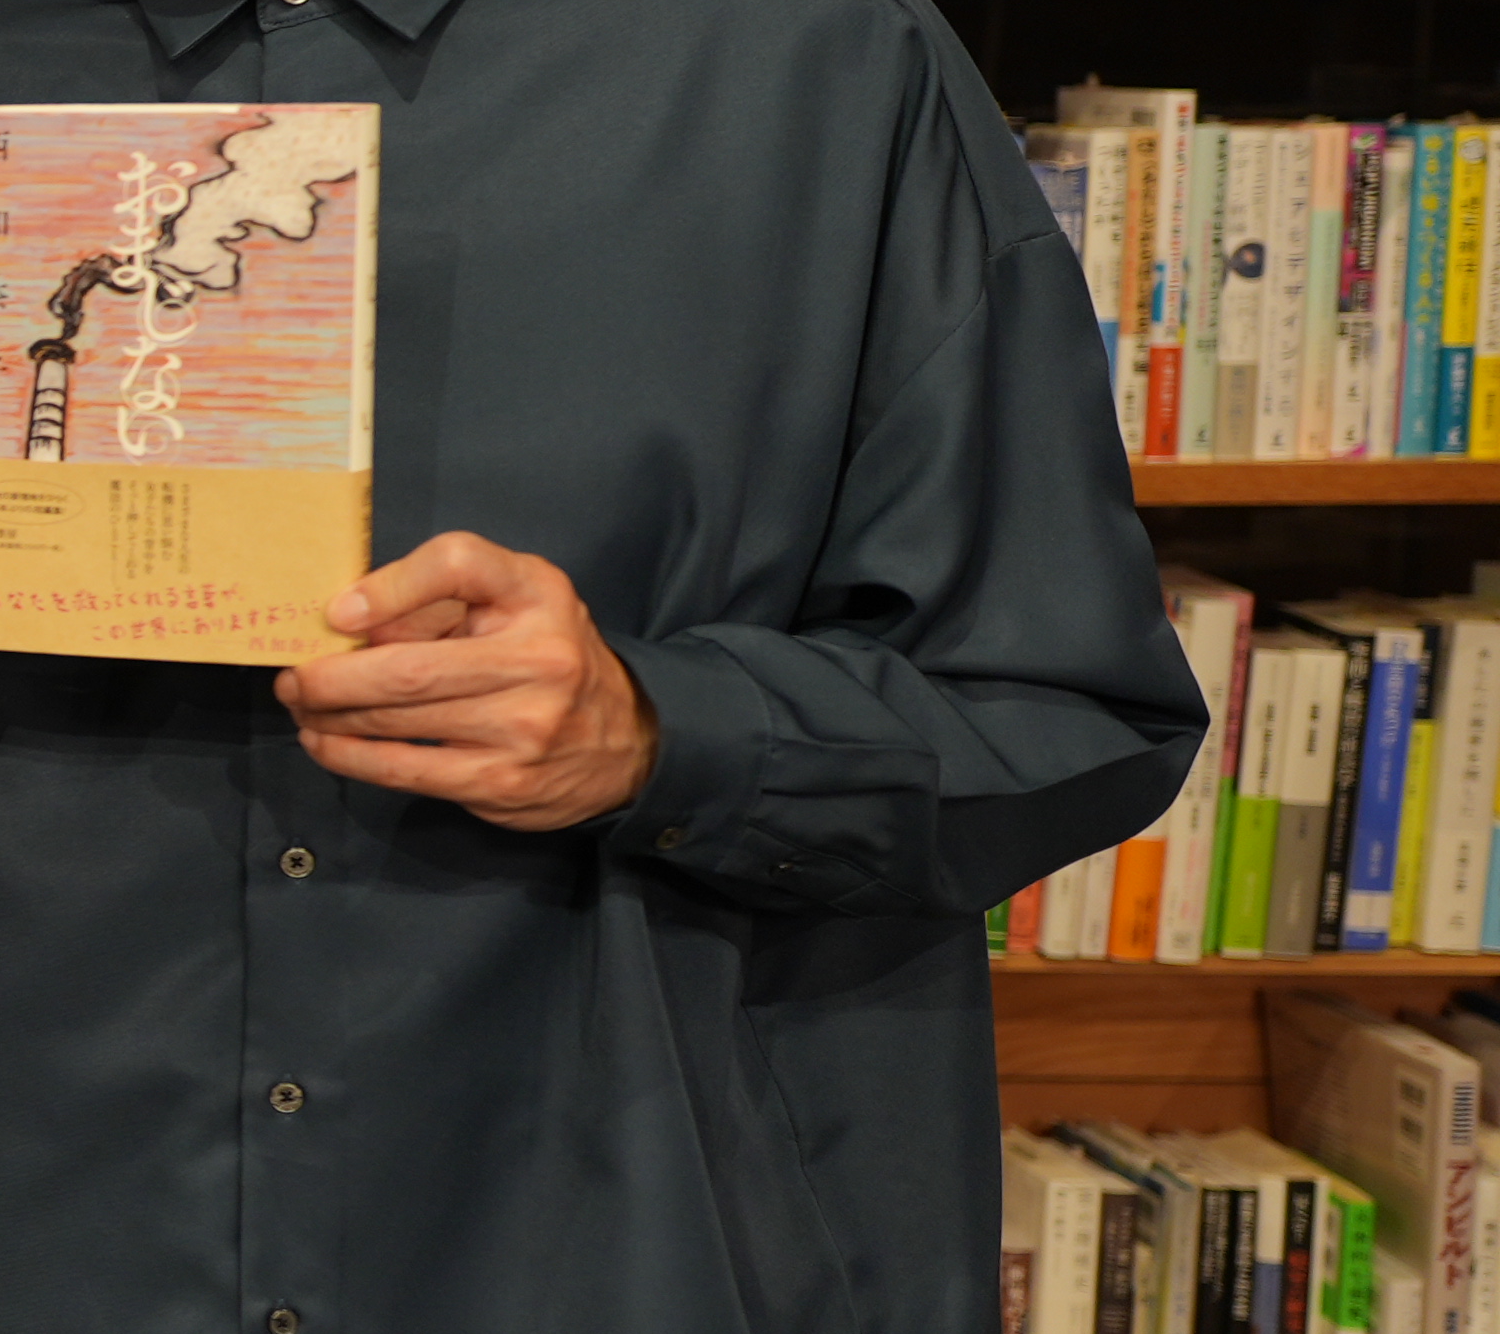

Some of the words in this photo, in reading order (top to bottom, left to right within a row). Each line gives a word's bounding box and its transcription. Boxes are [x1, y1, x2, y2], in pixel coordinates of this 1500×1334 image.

[111, 151, 199, 457] おまじない
